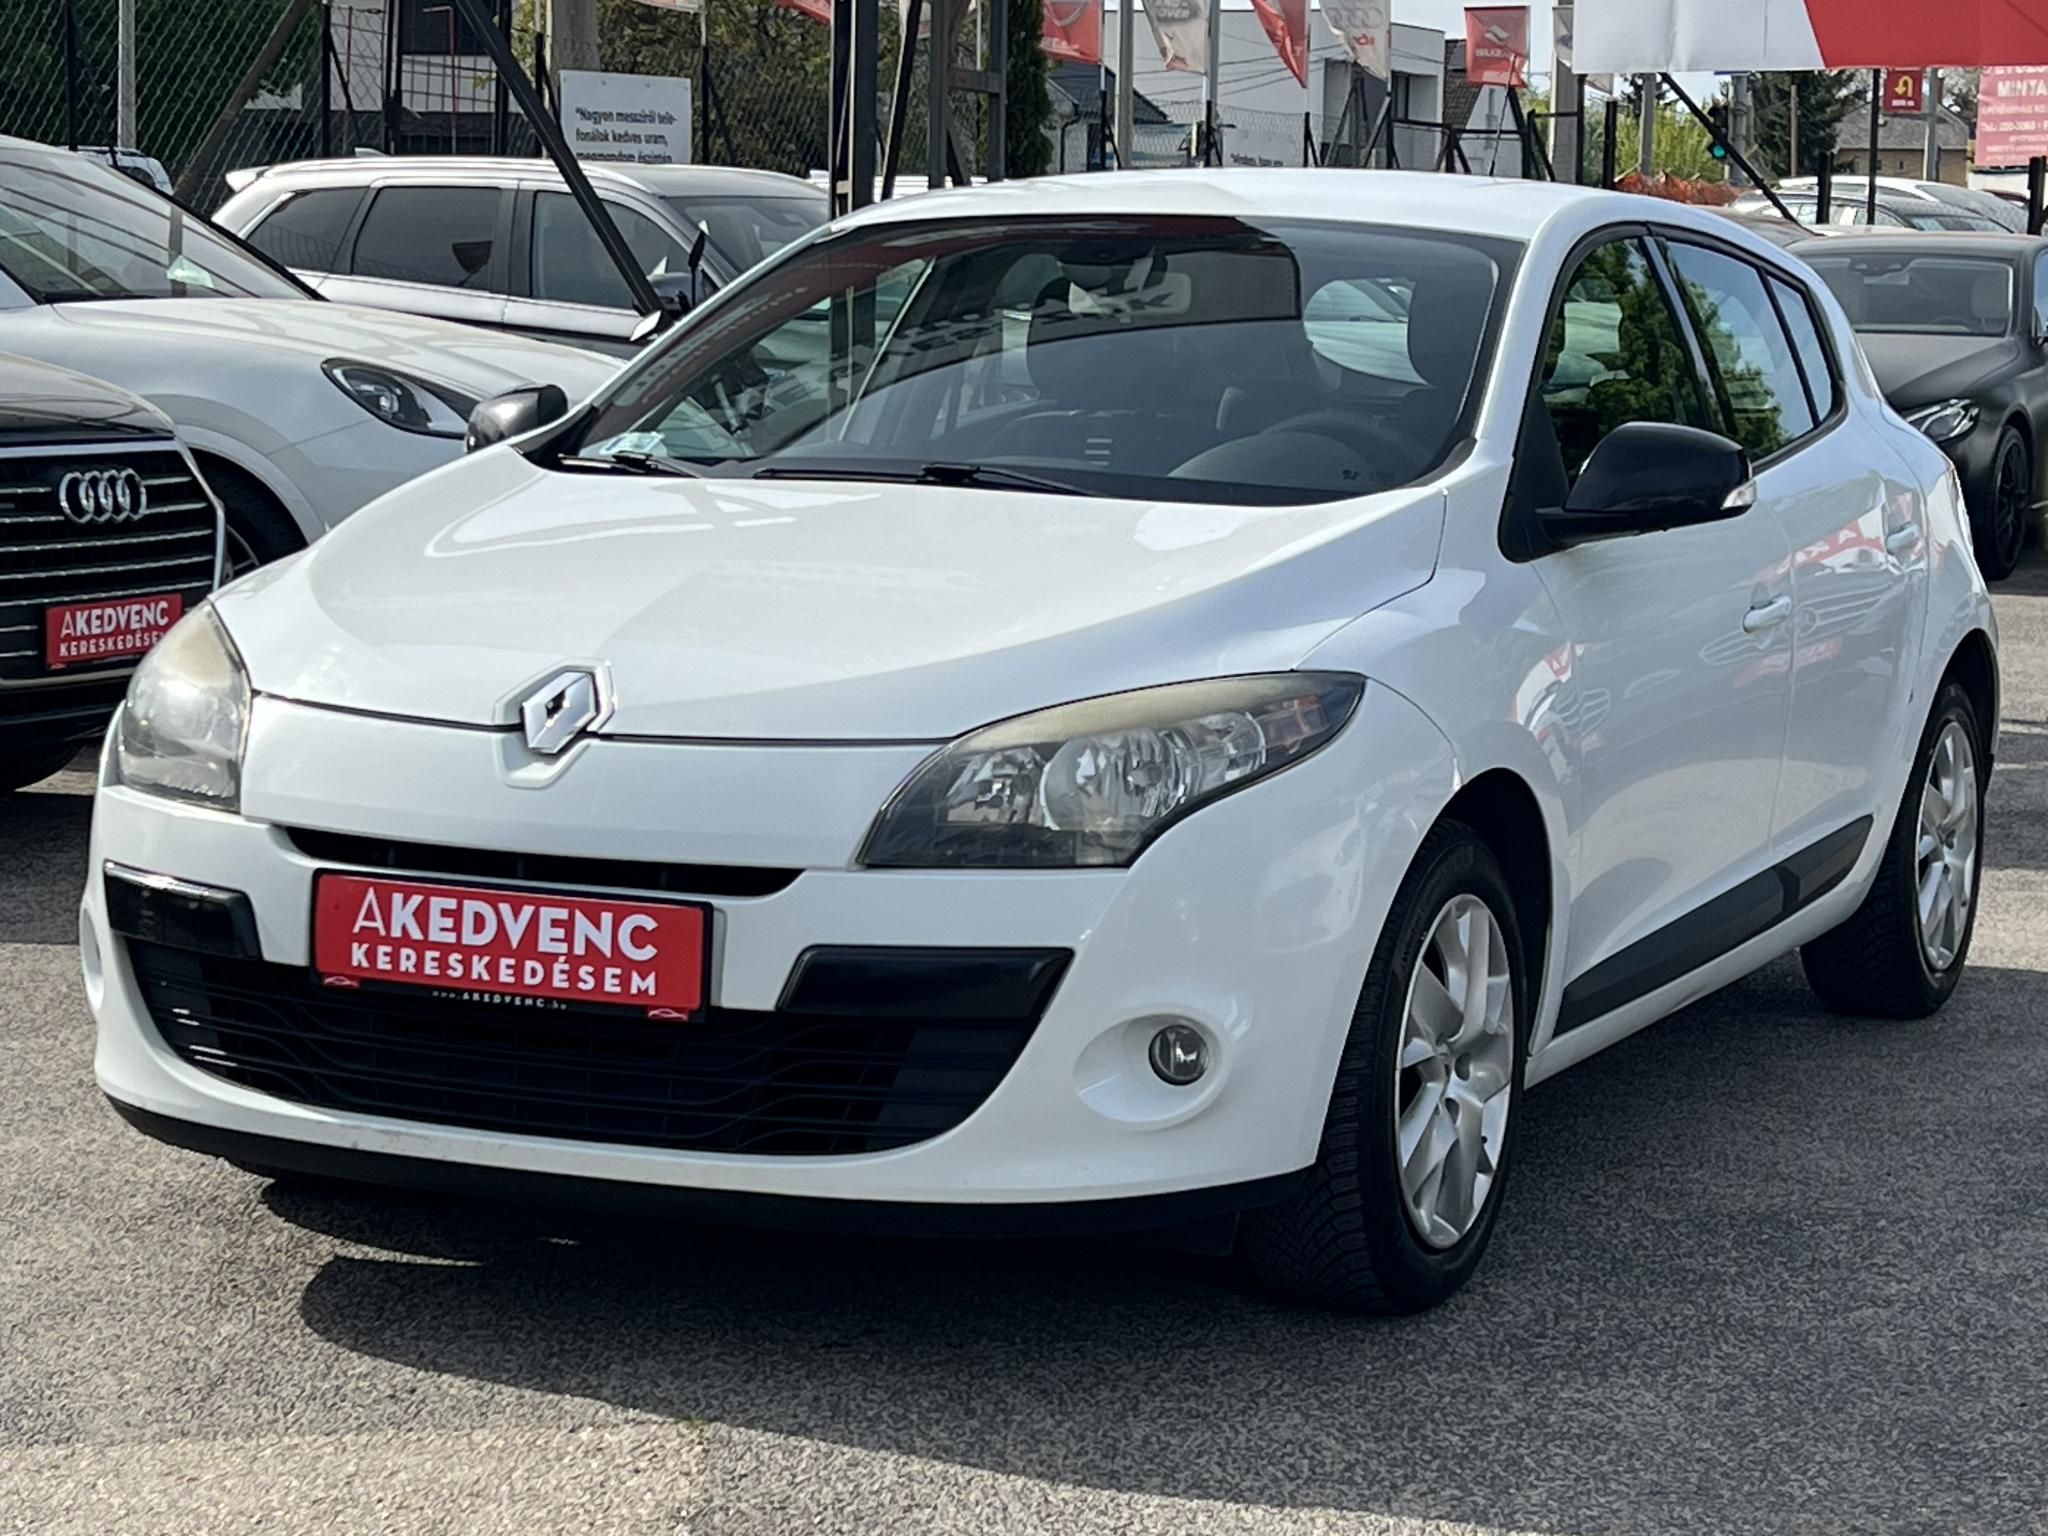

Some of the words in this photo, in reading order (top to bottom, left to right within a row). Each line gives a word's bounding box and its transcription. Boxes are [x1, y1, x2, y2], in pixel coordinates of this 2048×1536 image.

[611, 129, 642, 144] kedves
[60, 629, 166, 657] KERESKEDÉSE
[351, 942, 657, 996] KERESKEDÉSEM
